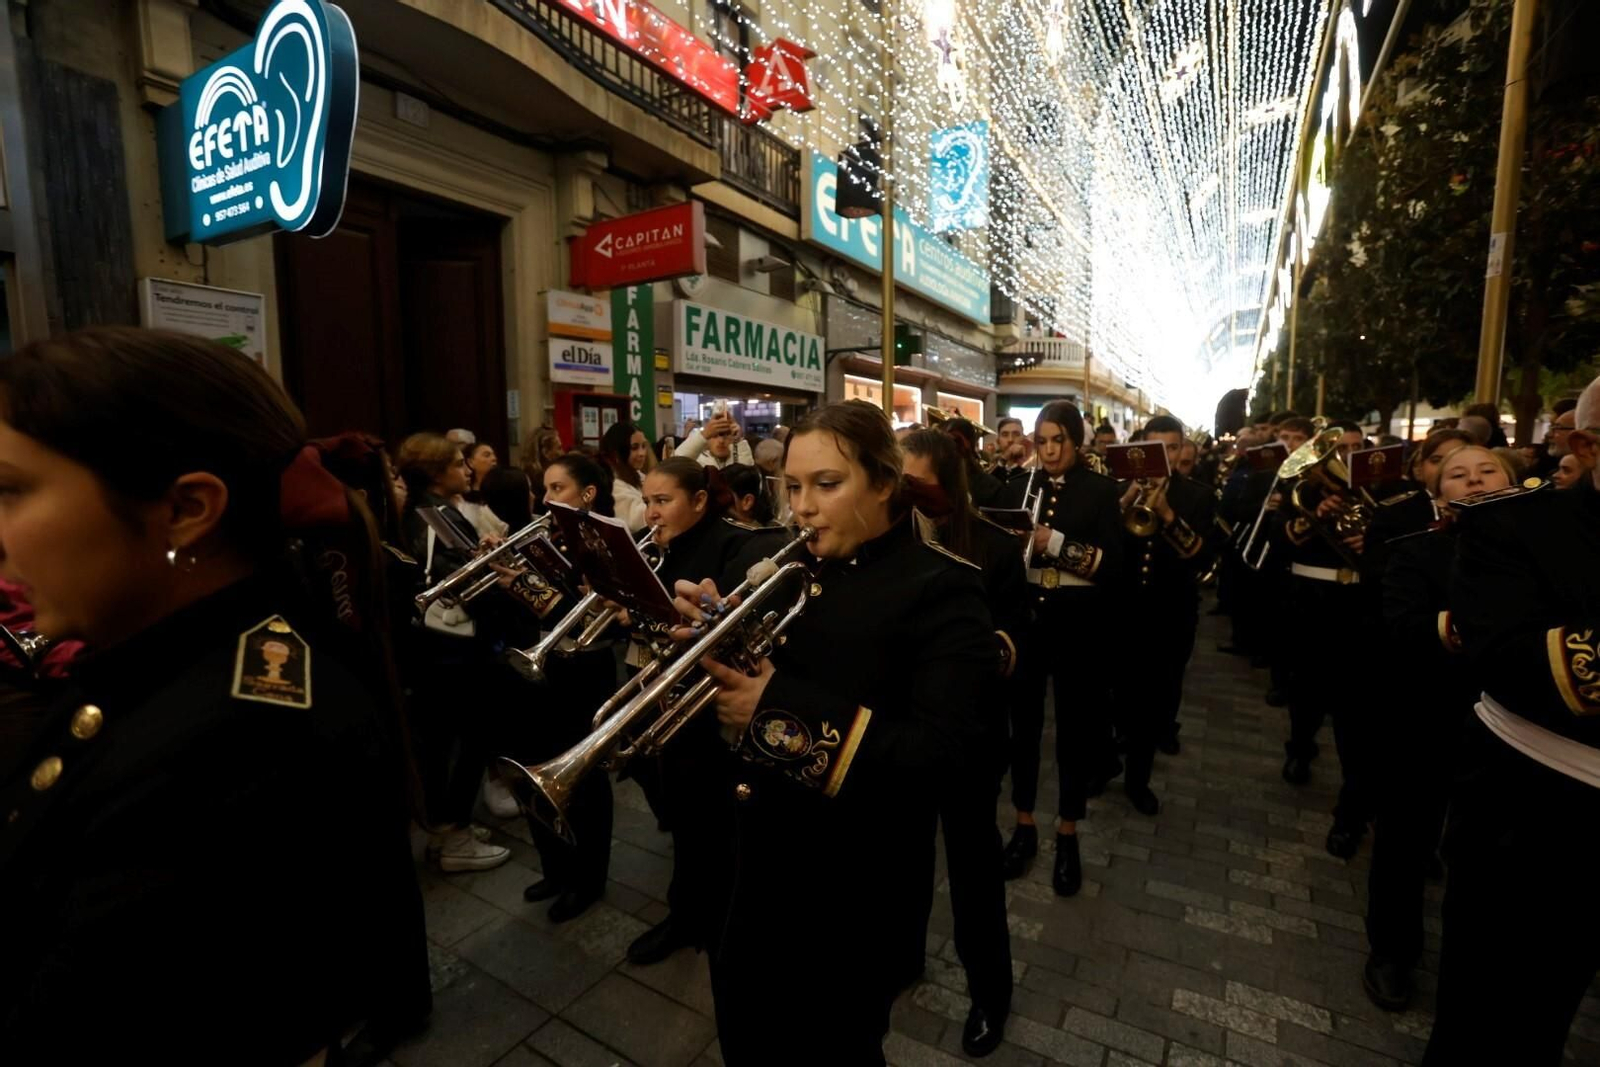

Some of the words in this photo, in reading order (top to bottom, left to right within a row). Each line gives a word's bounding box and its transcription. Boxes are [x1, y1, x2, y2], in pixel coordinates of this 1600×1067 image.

[189, 105, 270, 170] EFETA
[224, 158, 243, 181] Salud
[615, 223, 683, 250] CAPITAN
[153, 292, 212, 310] Tendremos
[214, 302, 223, 311] el
[686, 305, 821, 371] FARMACIA
